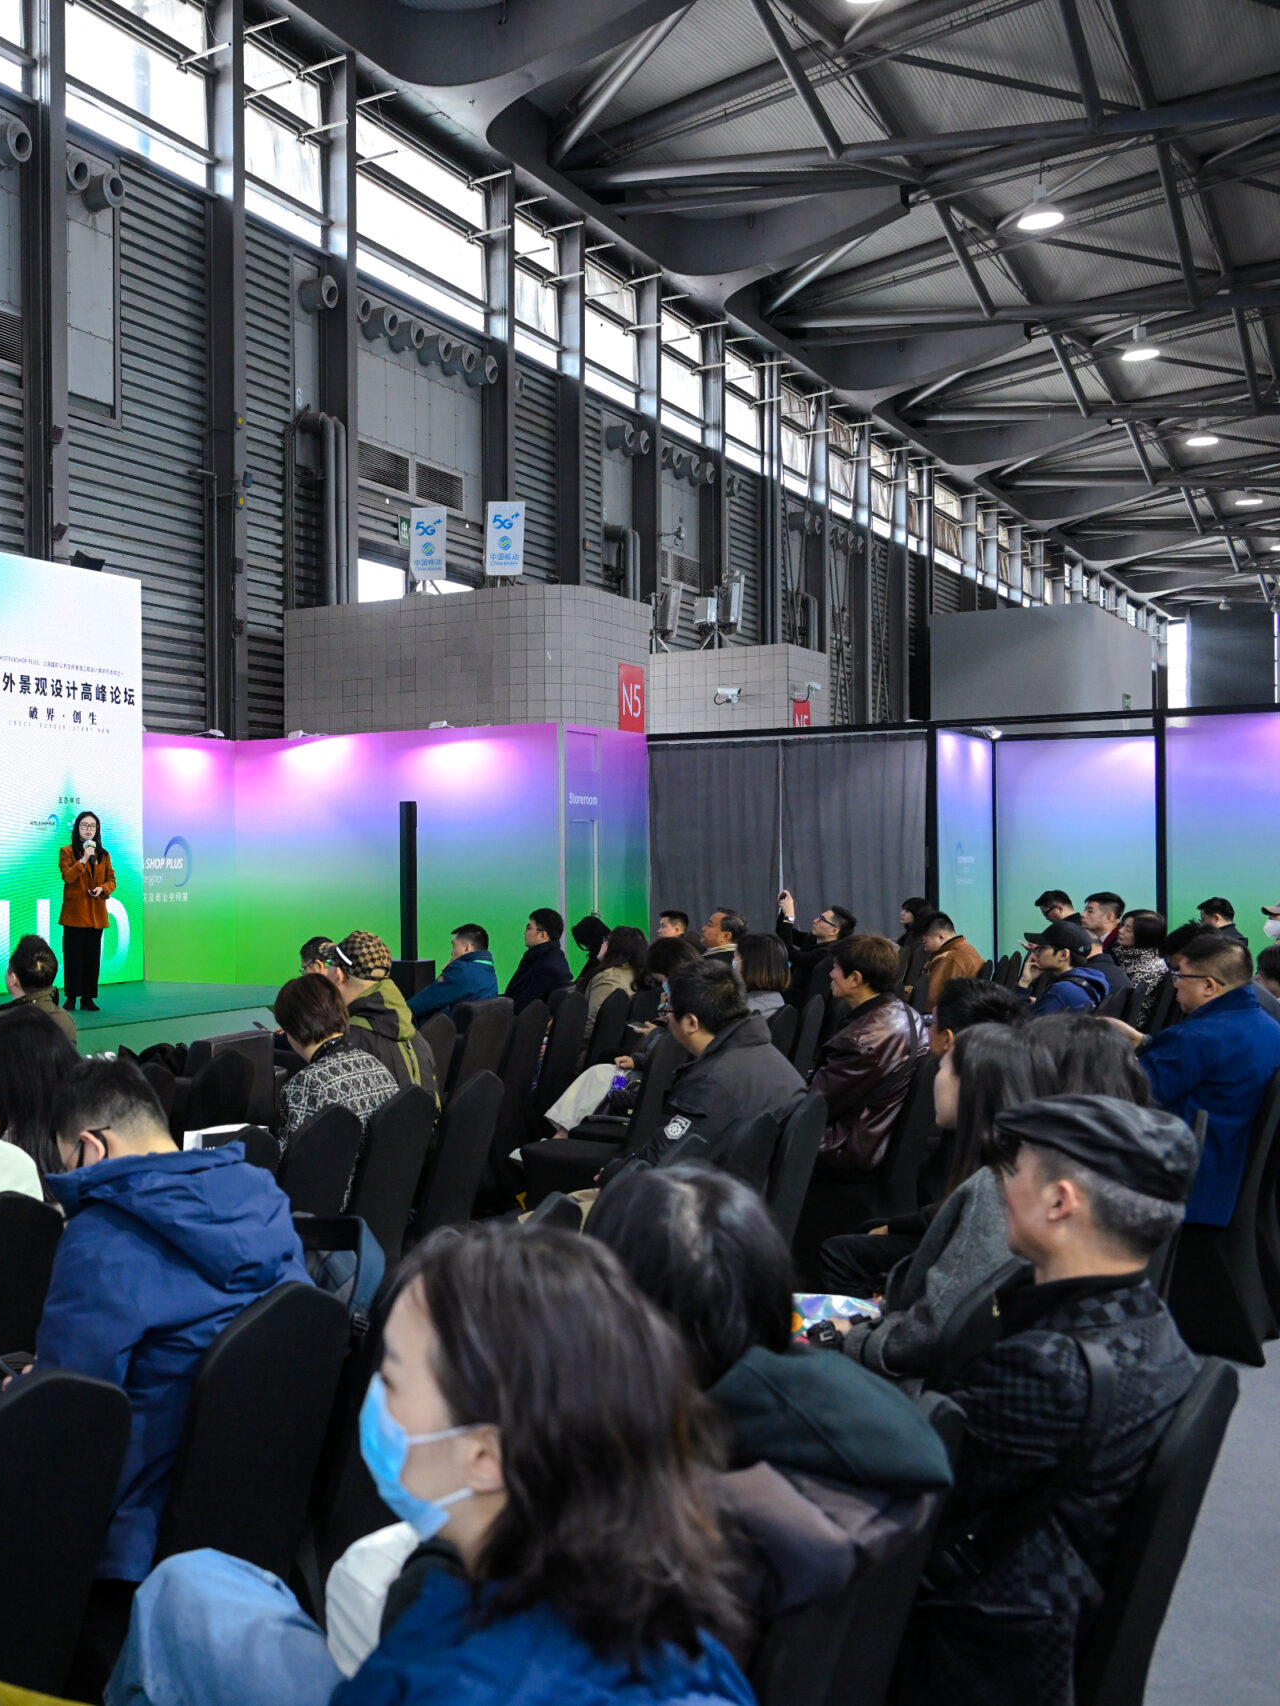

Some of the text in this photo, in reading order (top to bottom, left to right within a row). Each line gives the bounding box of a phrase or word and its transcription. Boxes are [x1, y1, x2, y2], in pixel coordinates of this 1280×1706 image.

[623, 681, 642, 718] N5
[569, 792, 598, 806] Storeroom
[145, 858, 165, 869] SHOP
[166, 858, 184, 869] PLUS
